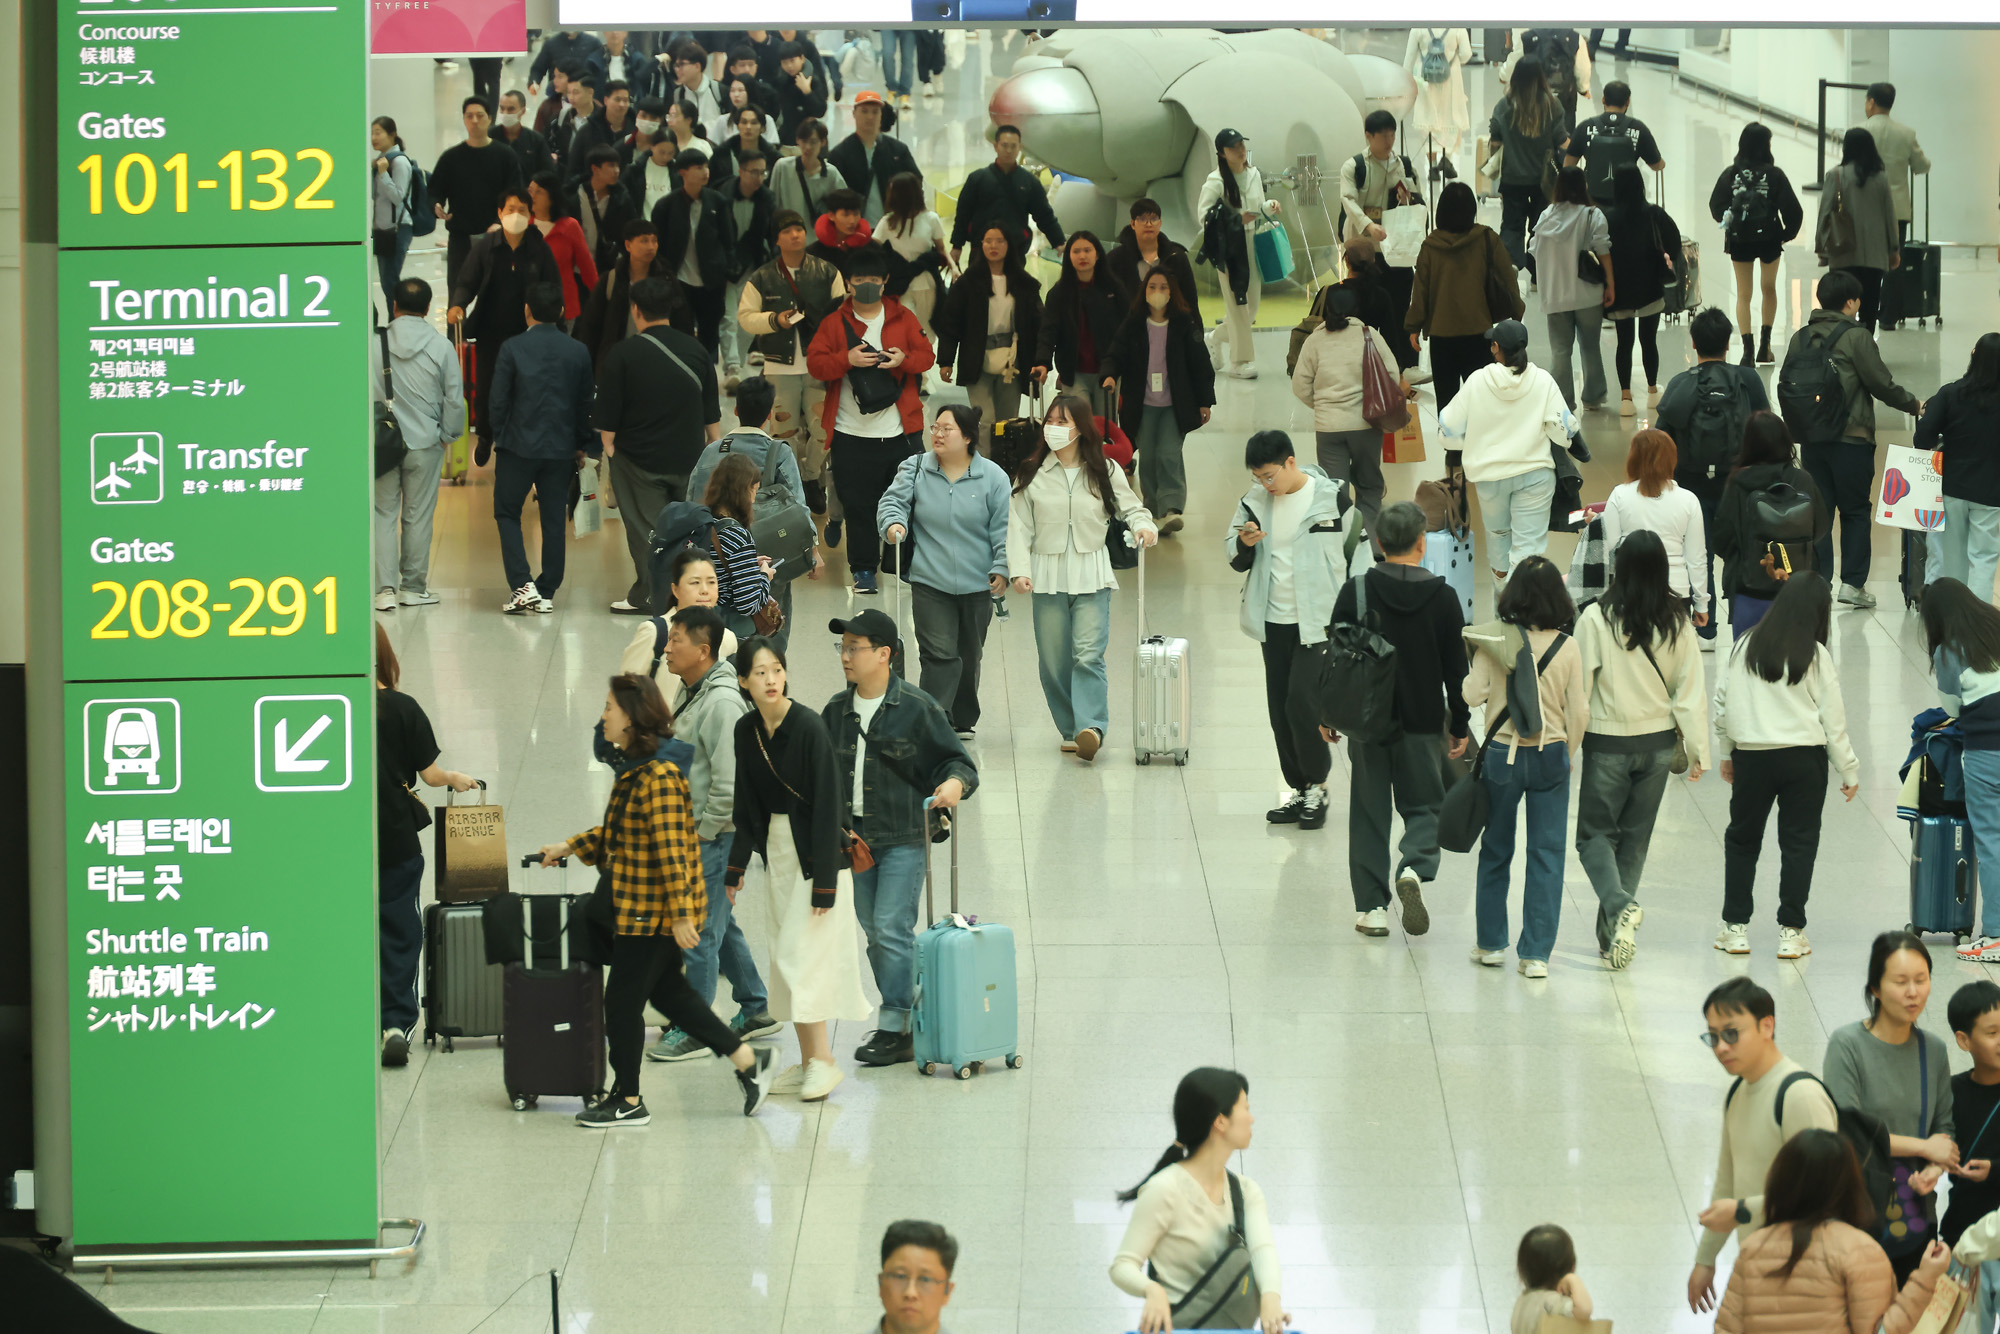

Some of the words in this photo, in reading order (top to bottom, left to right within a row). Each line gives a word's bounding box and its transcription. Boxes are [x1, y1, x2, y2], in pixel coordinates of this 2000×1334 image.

[78, 24, 181, 41] Concourse
[79, 46, 136, 65] 候机楼
[79, 70, 156, 86] コンコース
[77, 111, 167, 140] Gates
[77, 147, 335, 215] 101-132
[89, 274, 289, 321] Terminal
[303, 275, 331, 317] 2
[89, 337, 195, 357] 제2여객터미널
[89, 360, 168, 379] 2号航站楼
[89, 379, 246, 400] 第2旅客ターミナル
[177, 440, 310, 470] Transfer
[1909, 456, 1935, 466] DISCO
[1921, 474, 1942, 483] STOR
[1925, 466, 1936, 474] YO
[90, 536, 175, 564] Gates
[90, 576, 337, 640] 208-291
[448, 812, 501, 825] AIRSTAR
[84, 817, 232, 856] 셔틀트레인
[449, 825, 496, 838] AVENUE
[87, 865, 146, 903] 타는
[153, 864, 183, 901] 곳
[85, 926, 188, 955] Shuttle
[193, 925, 269, 953] Train
[86, 962, 217, 999] 航站列车
